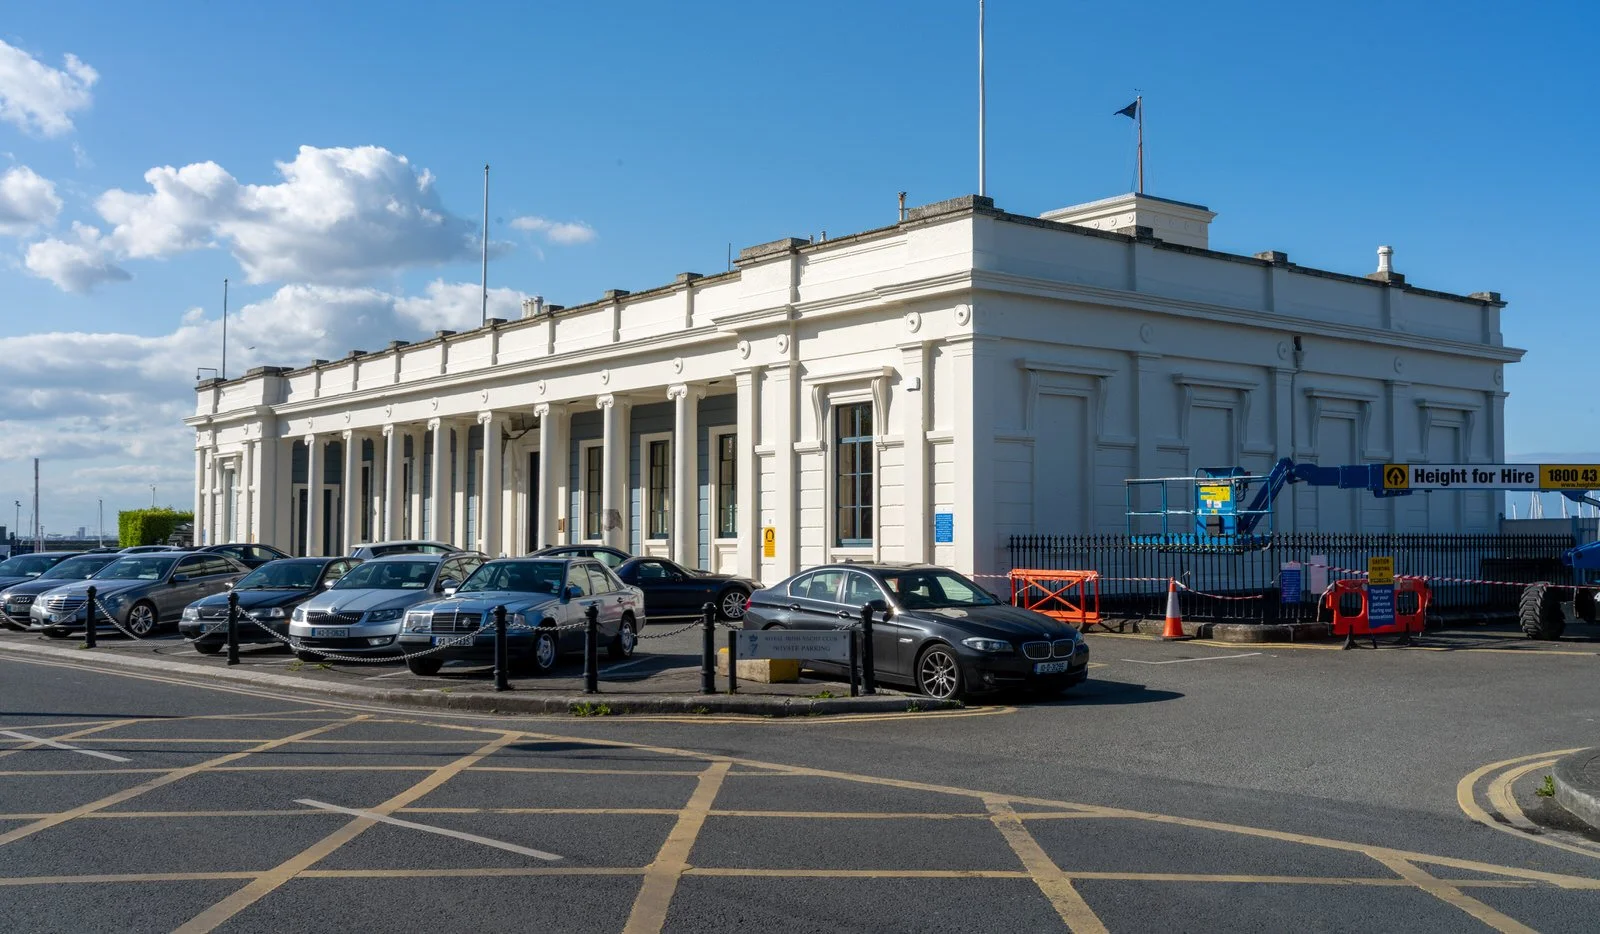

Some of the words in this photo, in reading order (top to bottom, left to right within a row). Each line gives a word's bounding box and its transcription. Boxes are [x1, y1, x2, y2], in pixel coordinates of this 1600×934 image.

[1414, 468, 1468, 486] Height
[1472, 468, 1496, 483] for
[1501, 468, 1535, 484] Hire
[1548, 469, 1578, 482] 1800
[1581, 469, 1598, 482] 43
